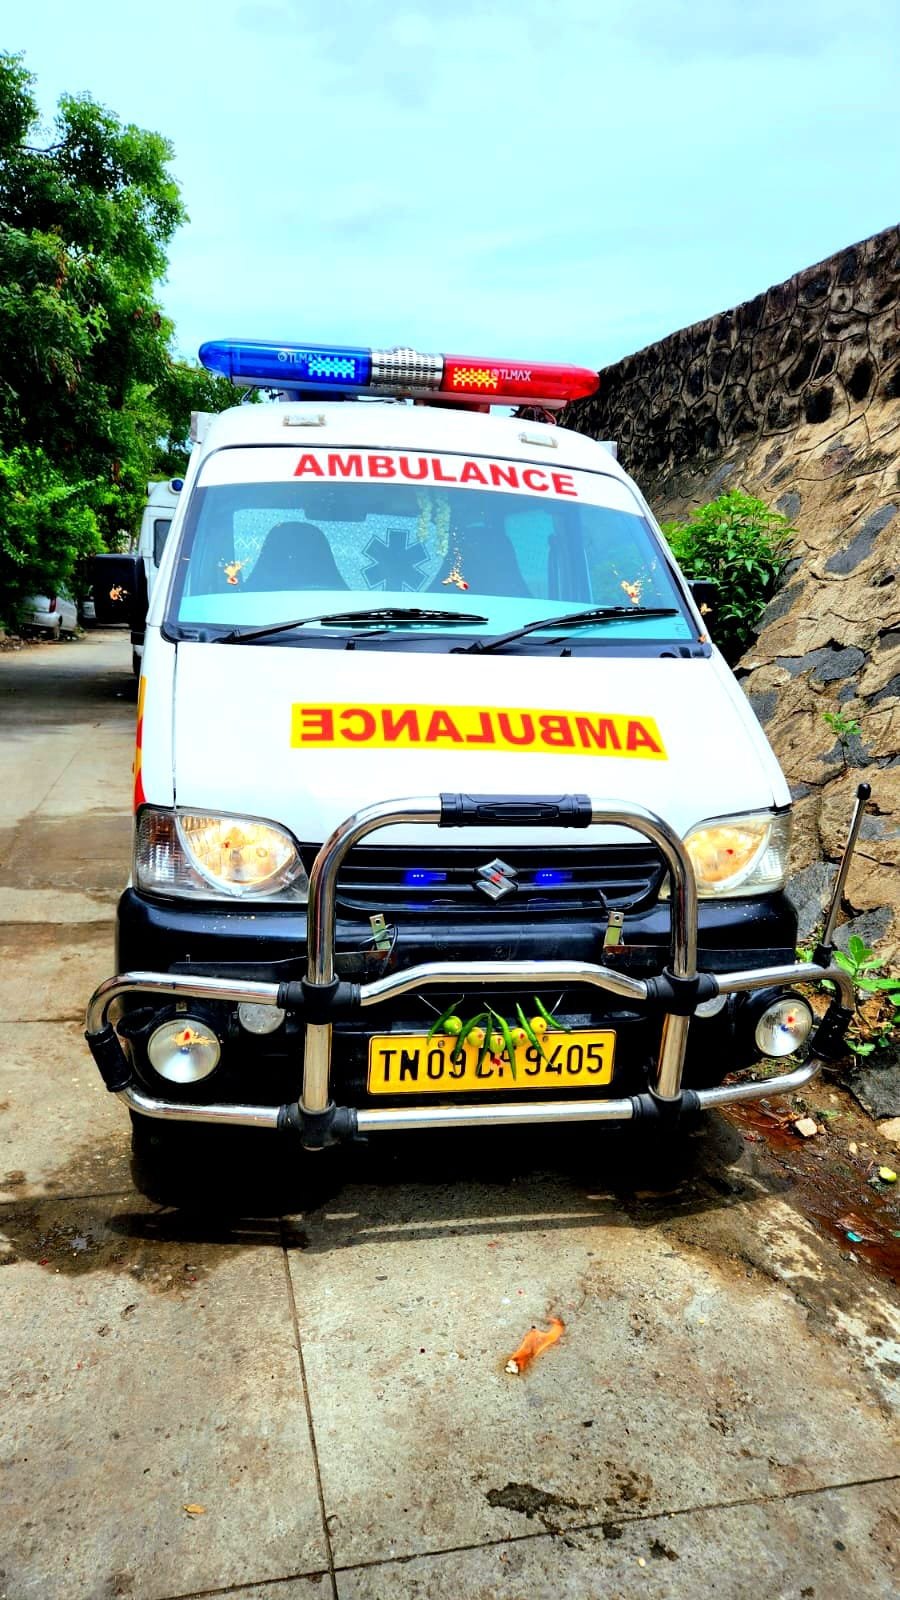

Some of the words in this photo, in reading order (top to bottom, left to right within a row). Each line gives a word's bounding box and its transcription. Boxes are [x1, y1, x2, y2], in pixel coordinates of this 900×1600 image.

[500, 369, 532, 382] TLMAX
[294, 454, 578, 497] AMBULANCE
[379, 1049, 419, 1082] TN
[427, 1047, 467, 1080] 09
[525, 1042, 604, 1076] 9405
